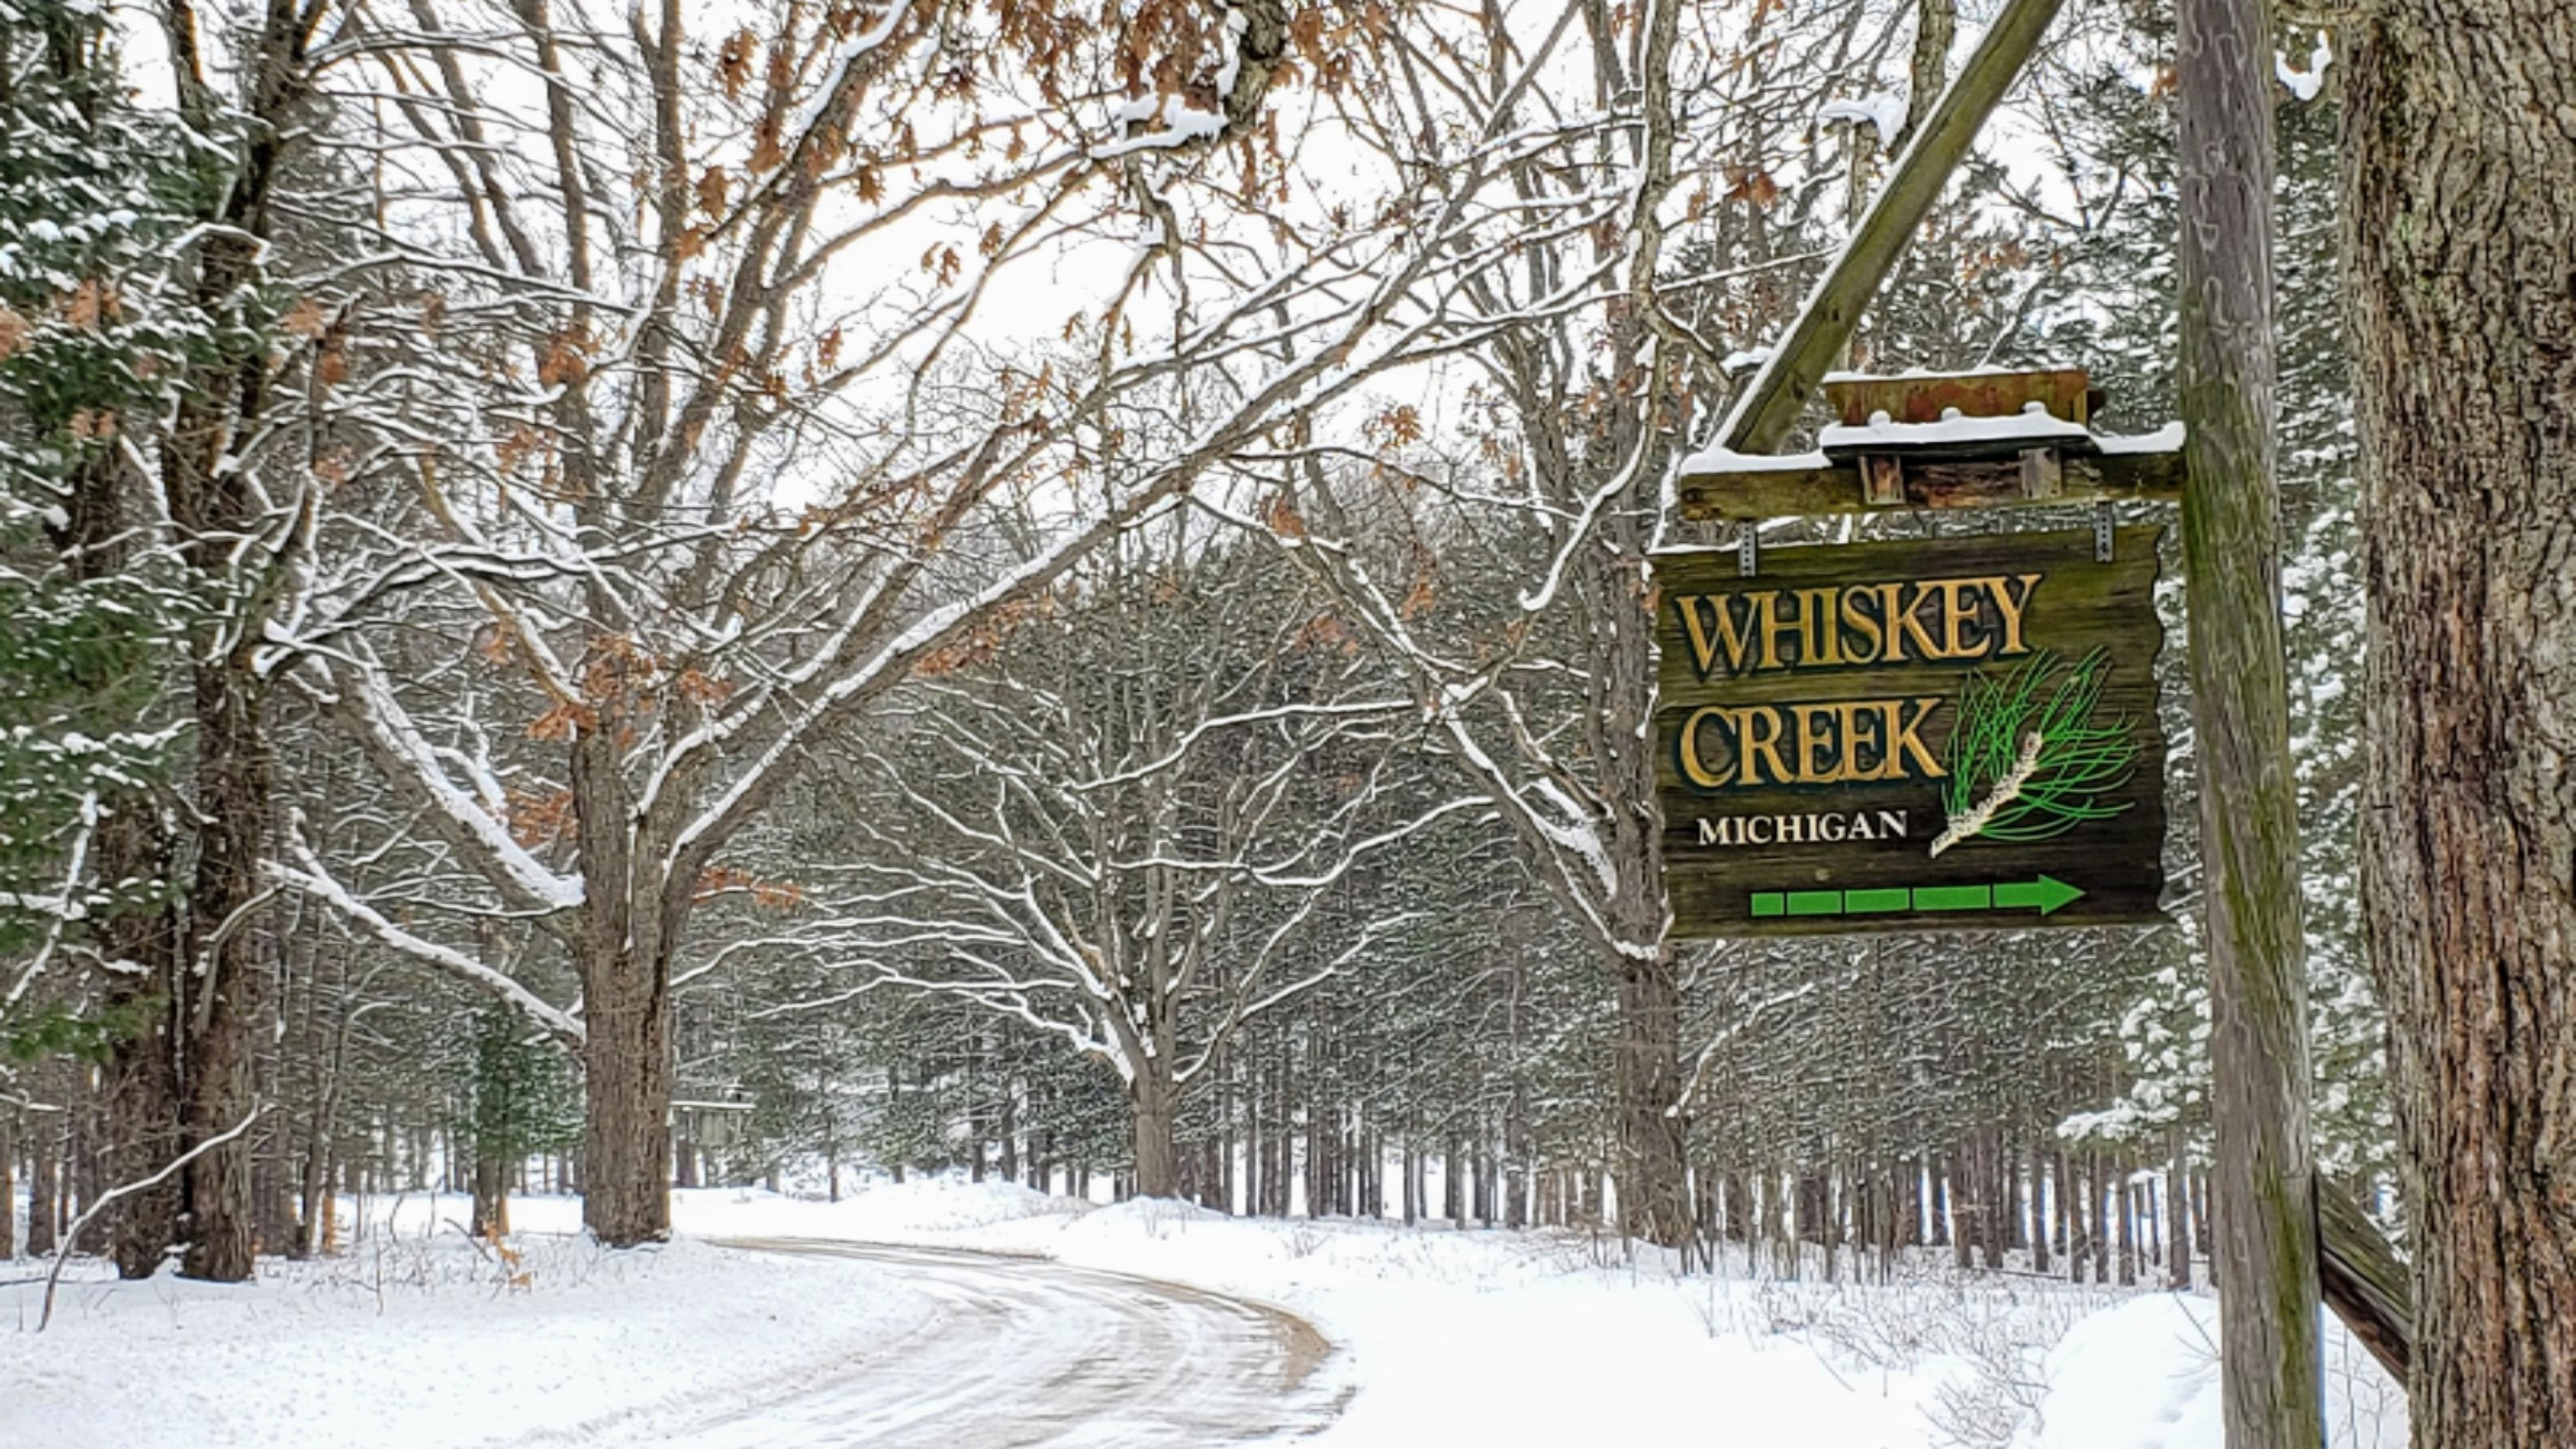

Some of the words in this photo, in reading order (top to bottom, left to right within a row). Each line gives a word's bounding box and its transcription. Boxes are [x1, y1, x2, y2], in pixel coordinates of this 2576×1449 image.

[1675, 573, 2044, 677] WHISKEY
[1678, 697, 1950, 789] CREEK
[1696, 809, 1908, 847] MICHIGAN
